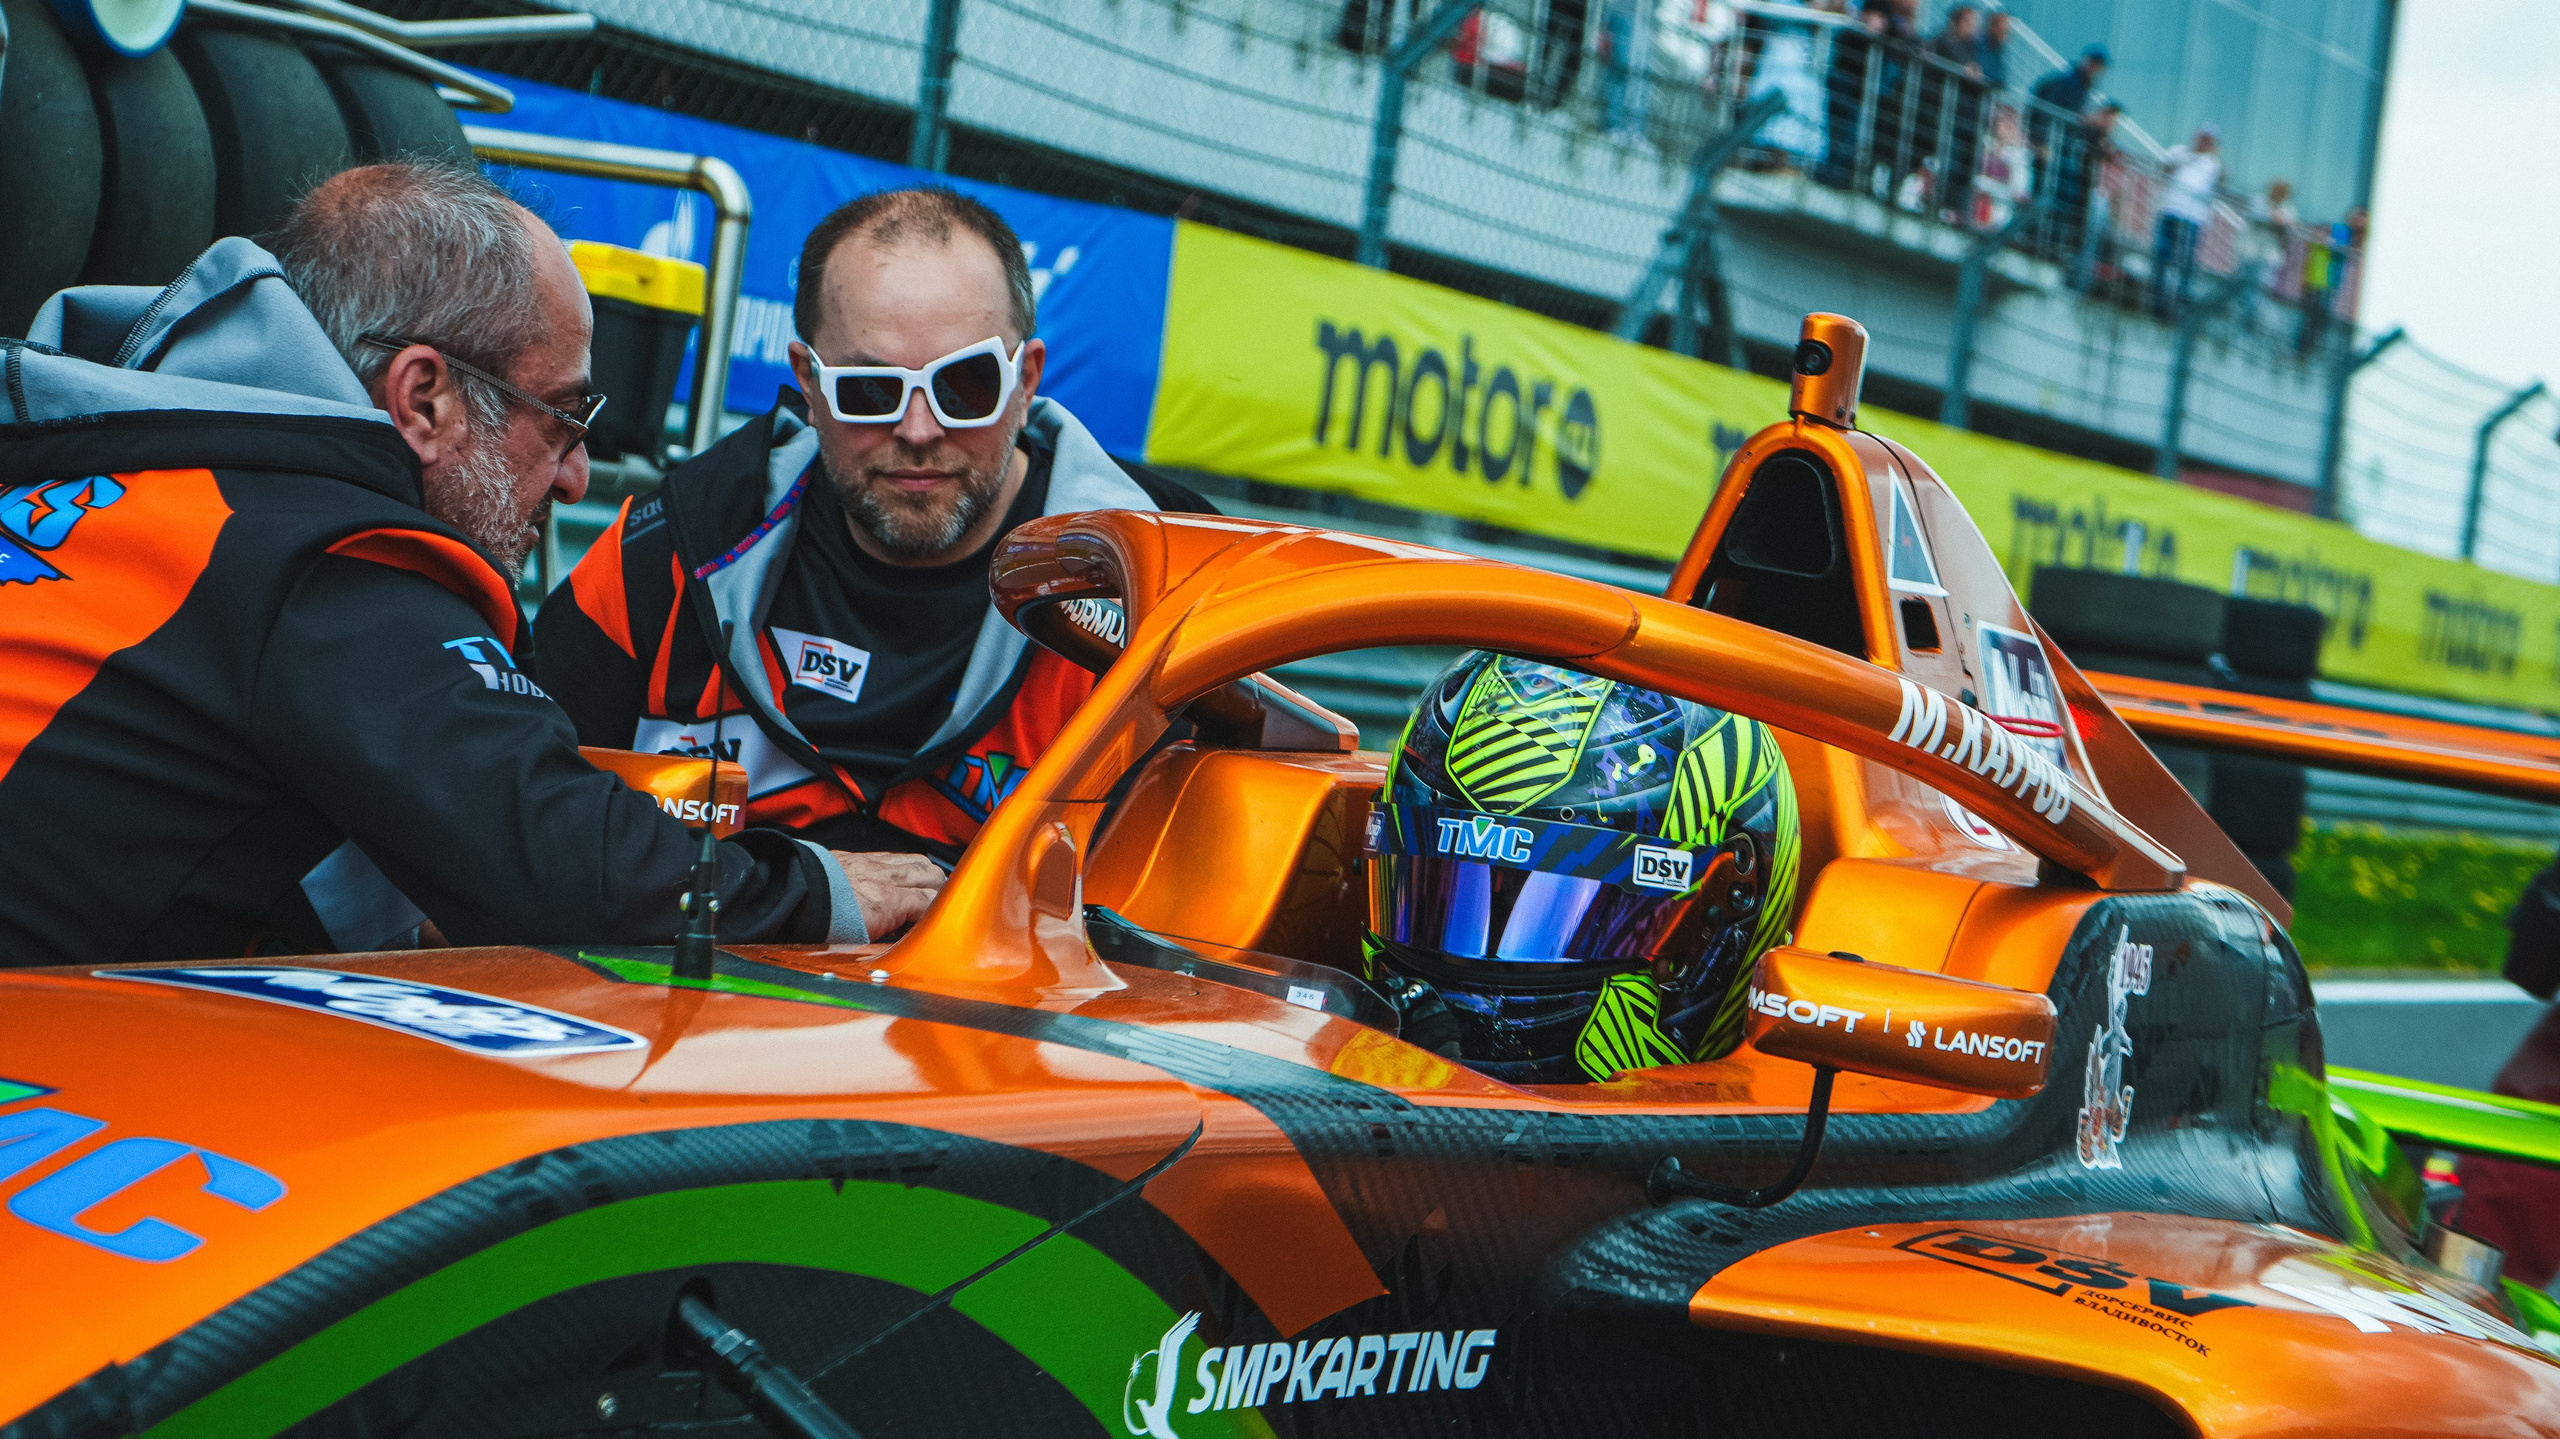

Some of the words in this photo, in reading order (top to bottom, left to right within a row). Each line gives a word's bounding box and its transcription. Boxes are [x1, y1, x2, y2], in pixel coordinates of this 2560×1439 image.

[1315, 320, 1553, 488] motor
[802, 648, 862, 683] DSV
[652, 795, 740, 825] NSOFT
[1437, 815, 1534, 864] TMC
[1641, 856, 1689, 880] DSV
[1748, 985, 1866, 1034] MSOFT
[1934, 1026, 2046, 1065] LANSOFT
[1930, 1235, 2258, 1318] DSV
[2072, 1296, 2212, 1358] ВЛАДИВОСТОК
[2080, 1289, 2194, 1331] ДОРСЕРВИС
